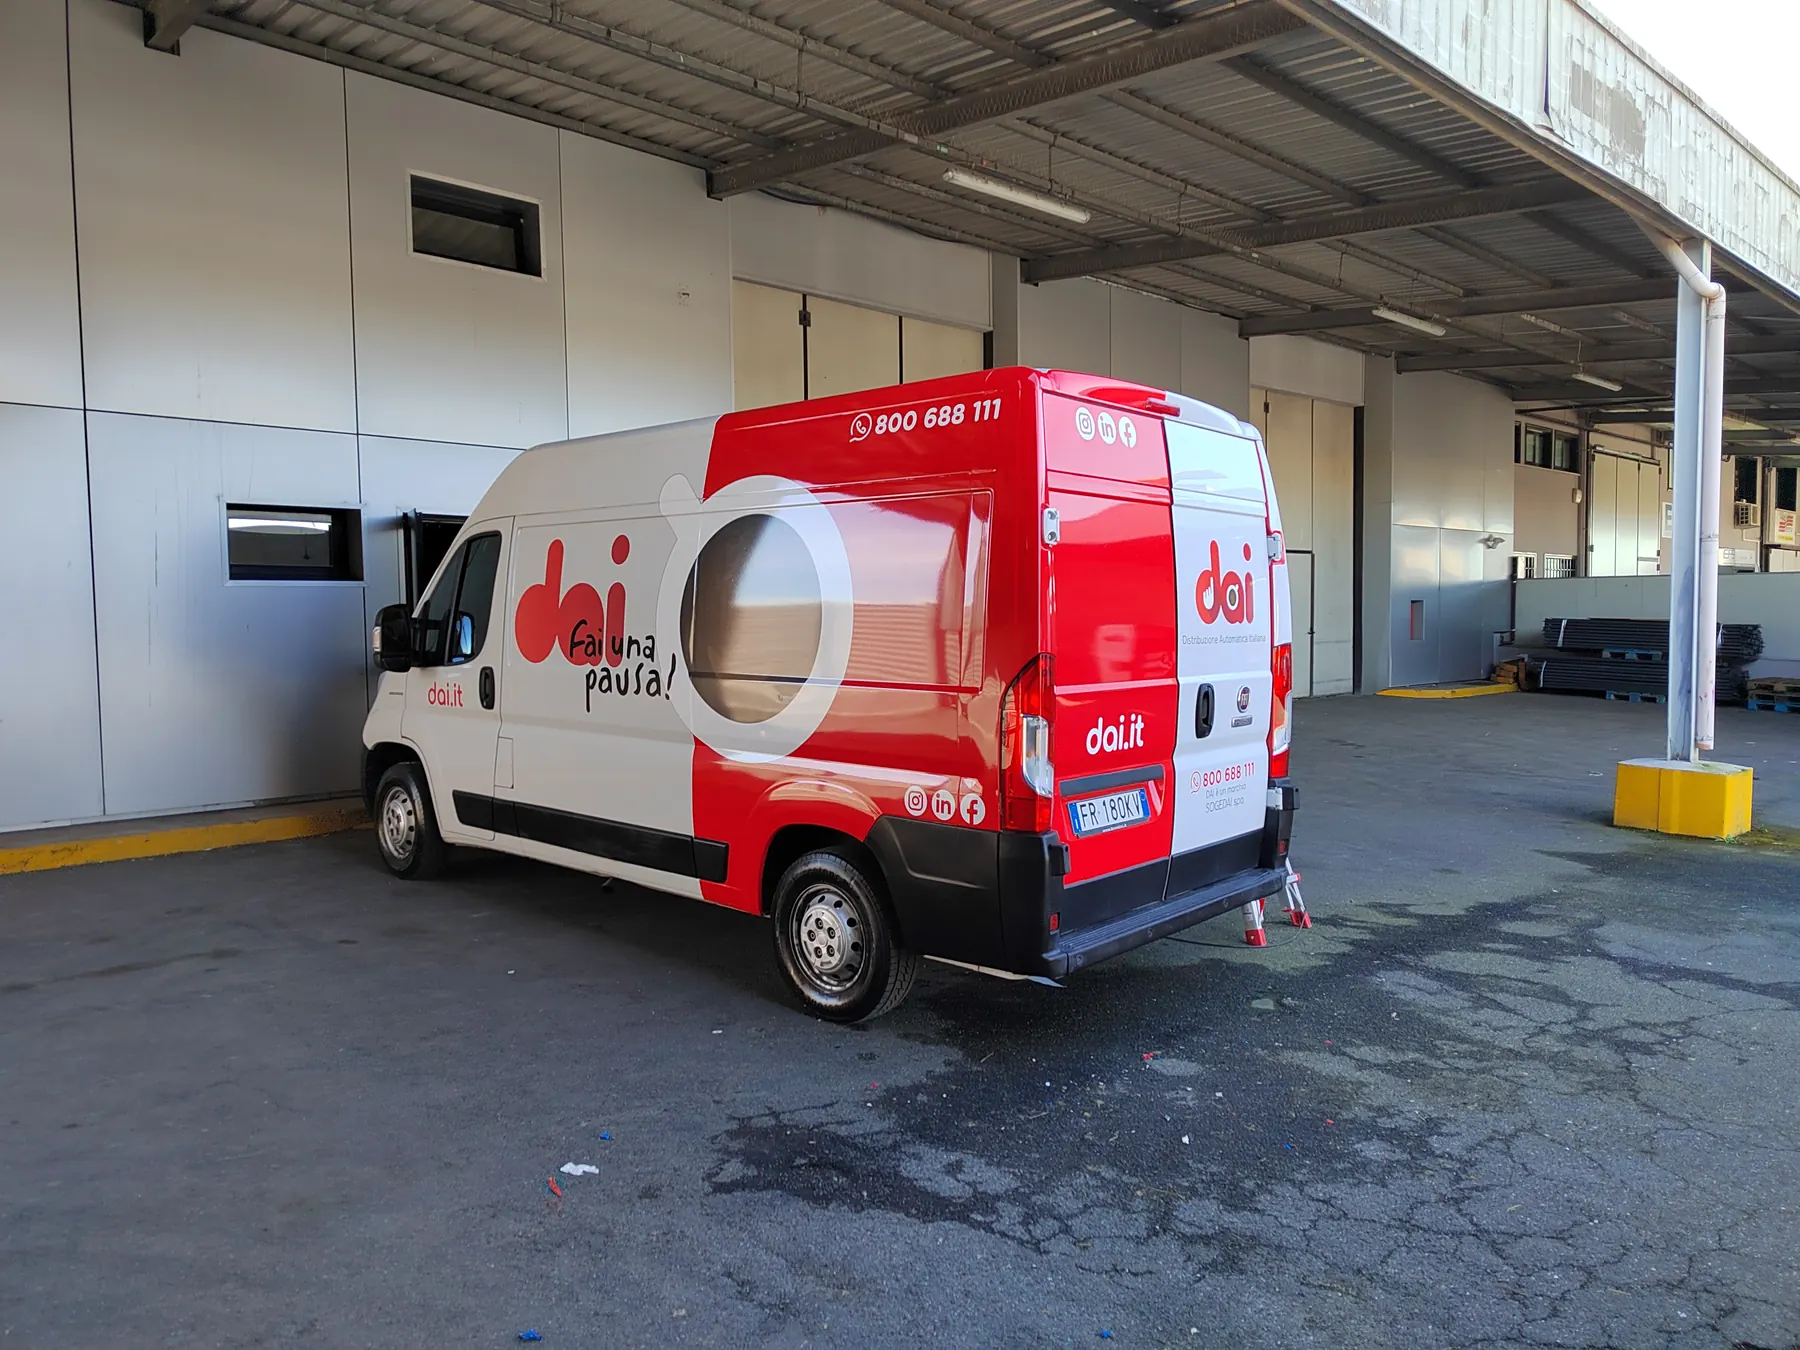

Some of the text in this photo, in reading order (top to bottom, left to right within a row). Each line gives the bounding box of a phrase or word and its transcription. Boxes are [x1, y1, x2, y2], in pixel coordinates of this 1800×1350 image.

[875, 398, 1001, 434] 800 688 111
[515, 534, 630, 667] dai
[1195, 540, 1254, 624] dai
[569, 619, 656, 663] Fai una
[427, 681, 463, 707] dai.it
[585, 652, 677, 713] pausa!
[1086, 714, 1145, 755] dai.it
[1203, 762, 1255, 787] 800 688 111
[1080, 792, 1140, 828] FR 180KV
